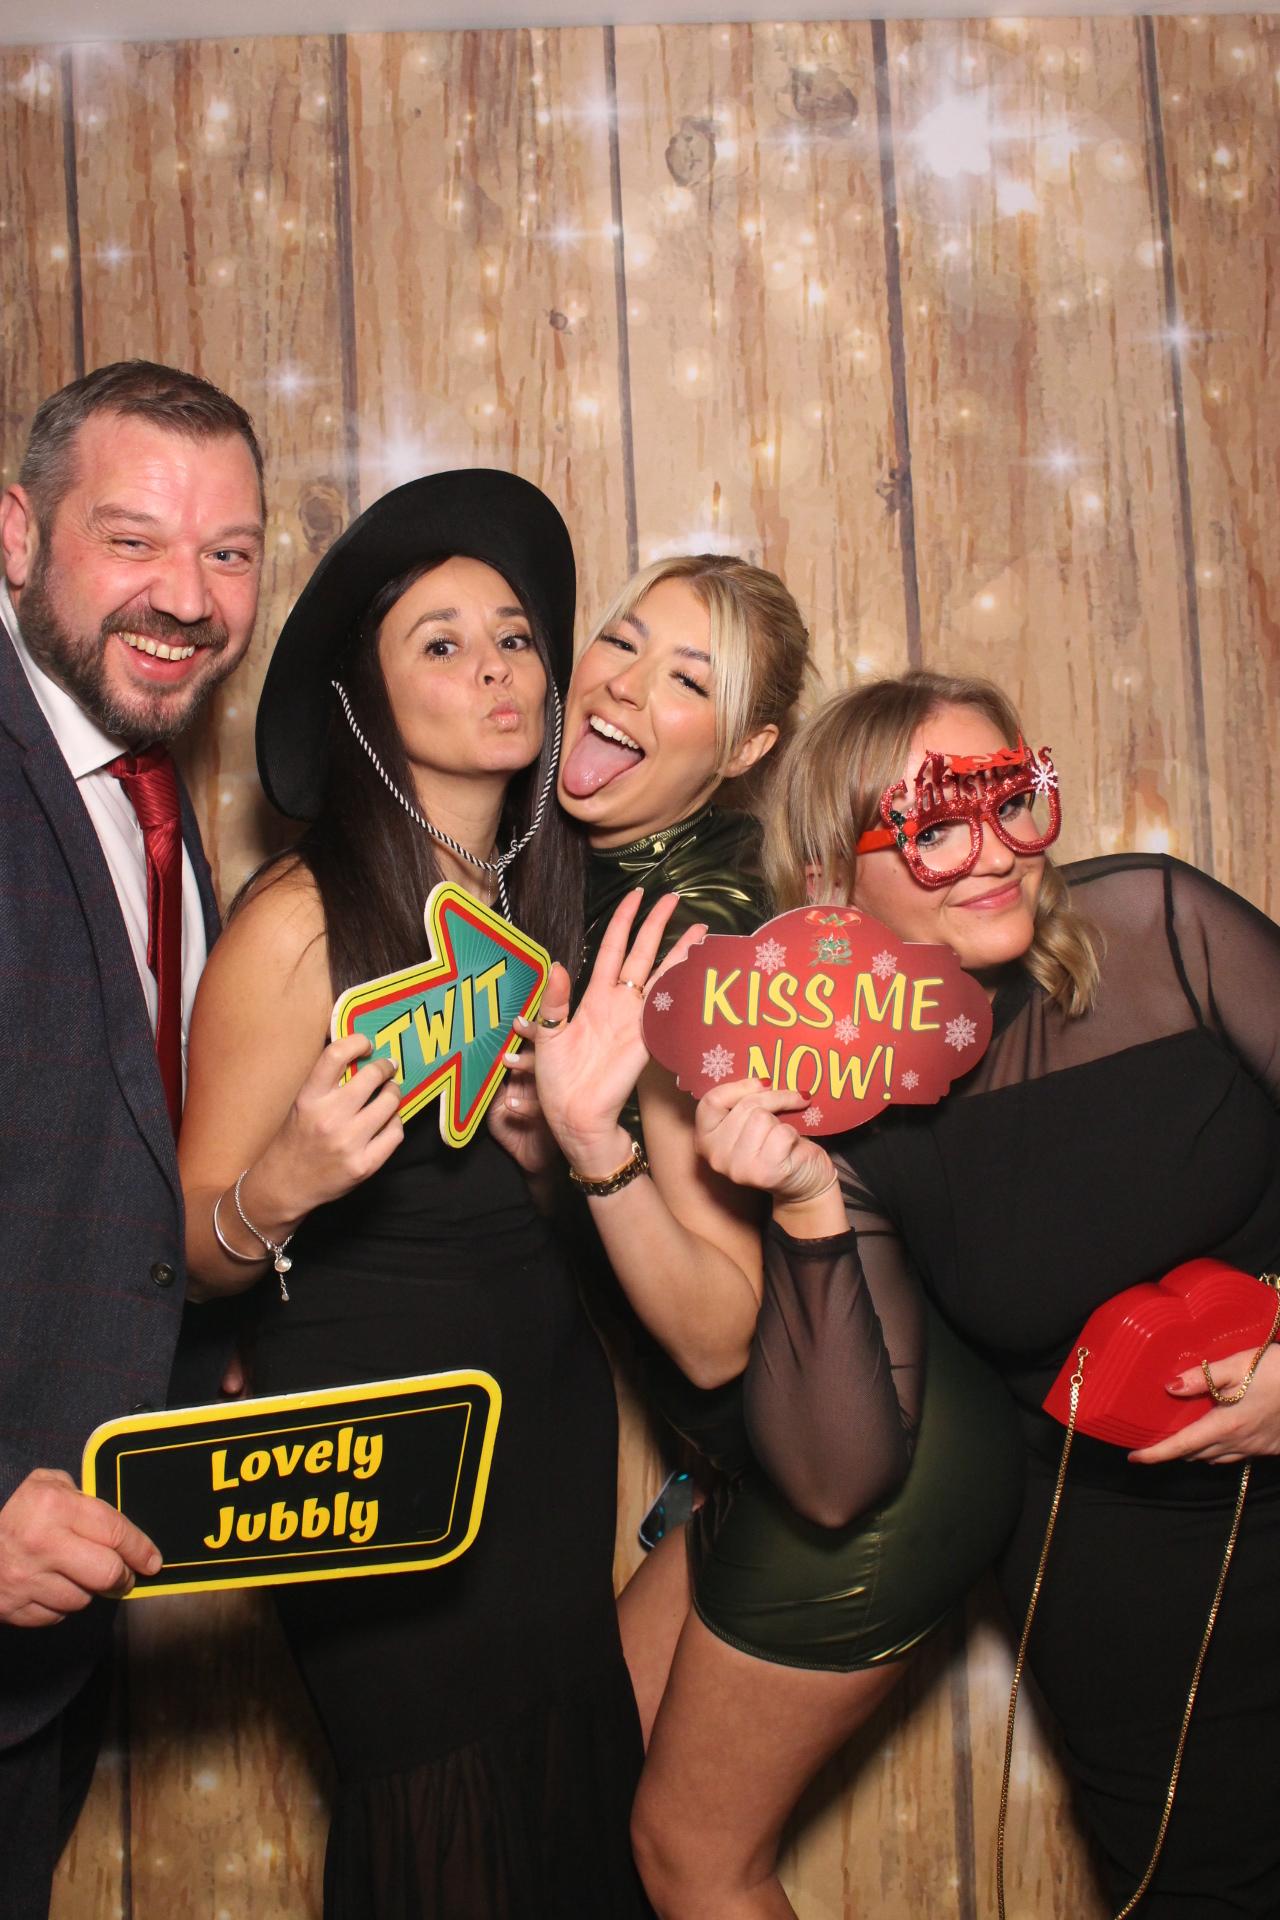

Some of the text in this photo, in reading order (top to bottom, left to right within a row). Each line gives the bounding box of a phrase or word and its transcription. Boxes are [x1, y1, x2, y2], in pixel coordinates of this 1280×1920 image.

[374, 956, 508, 1085] TWIT
[702, 967, 945, 1032] KISS ME
[747, 1038, 895, 1101] NOW!
[211, 1426, 383, 1491] Lovely
[203, 1491, 379, 1549] Jubbly
